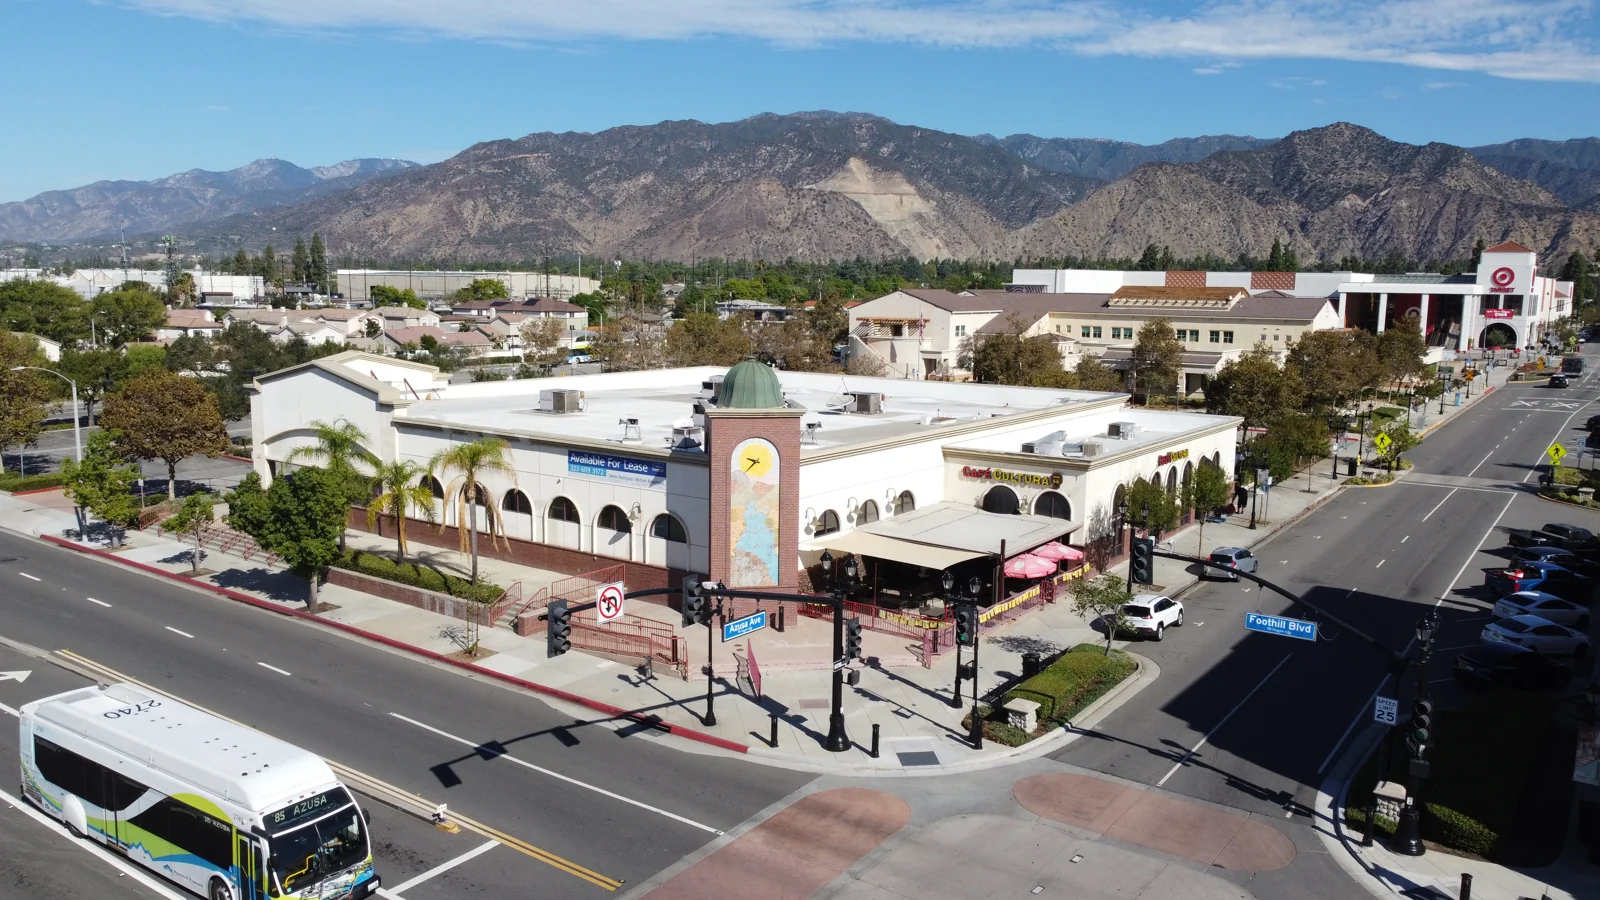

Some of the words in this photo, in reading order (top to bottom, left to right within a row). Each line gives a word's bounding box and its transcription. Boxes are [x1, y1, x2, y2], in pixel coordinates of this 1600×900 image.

[570, 453, 605, 467] Available
[607, 458, 621, 468] For
[624, 460, 648, 472] Lease
[993, 469, 1050, 486] CULTURA
[729, 620, 748, 633] Azusa
[749, 615, 762, 626] Ave
[1249, 615, 1286, 629] Foothill
[1288, 622, 1312, 634] Blvd
[103, 700, 162, 719] 2740
[1377, 698, 1396, 707] SPEED
[1376, 710, 1395, 722] 25
[274, 810, 286, 822] 85
[293, 794, 328, 816] AZUSA
